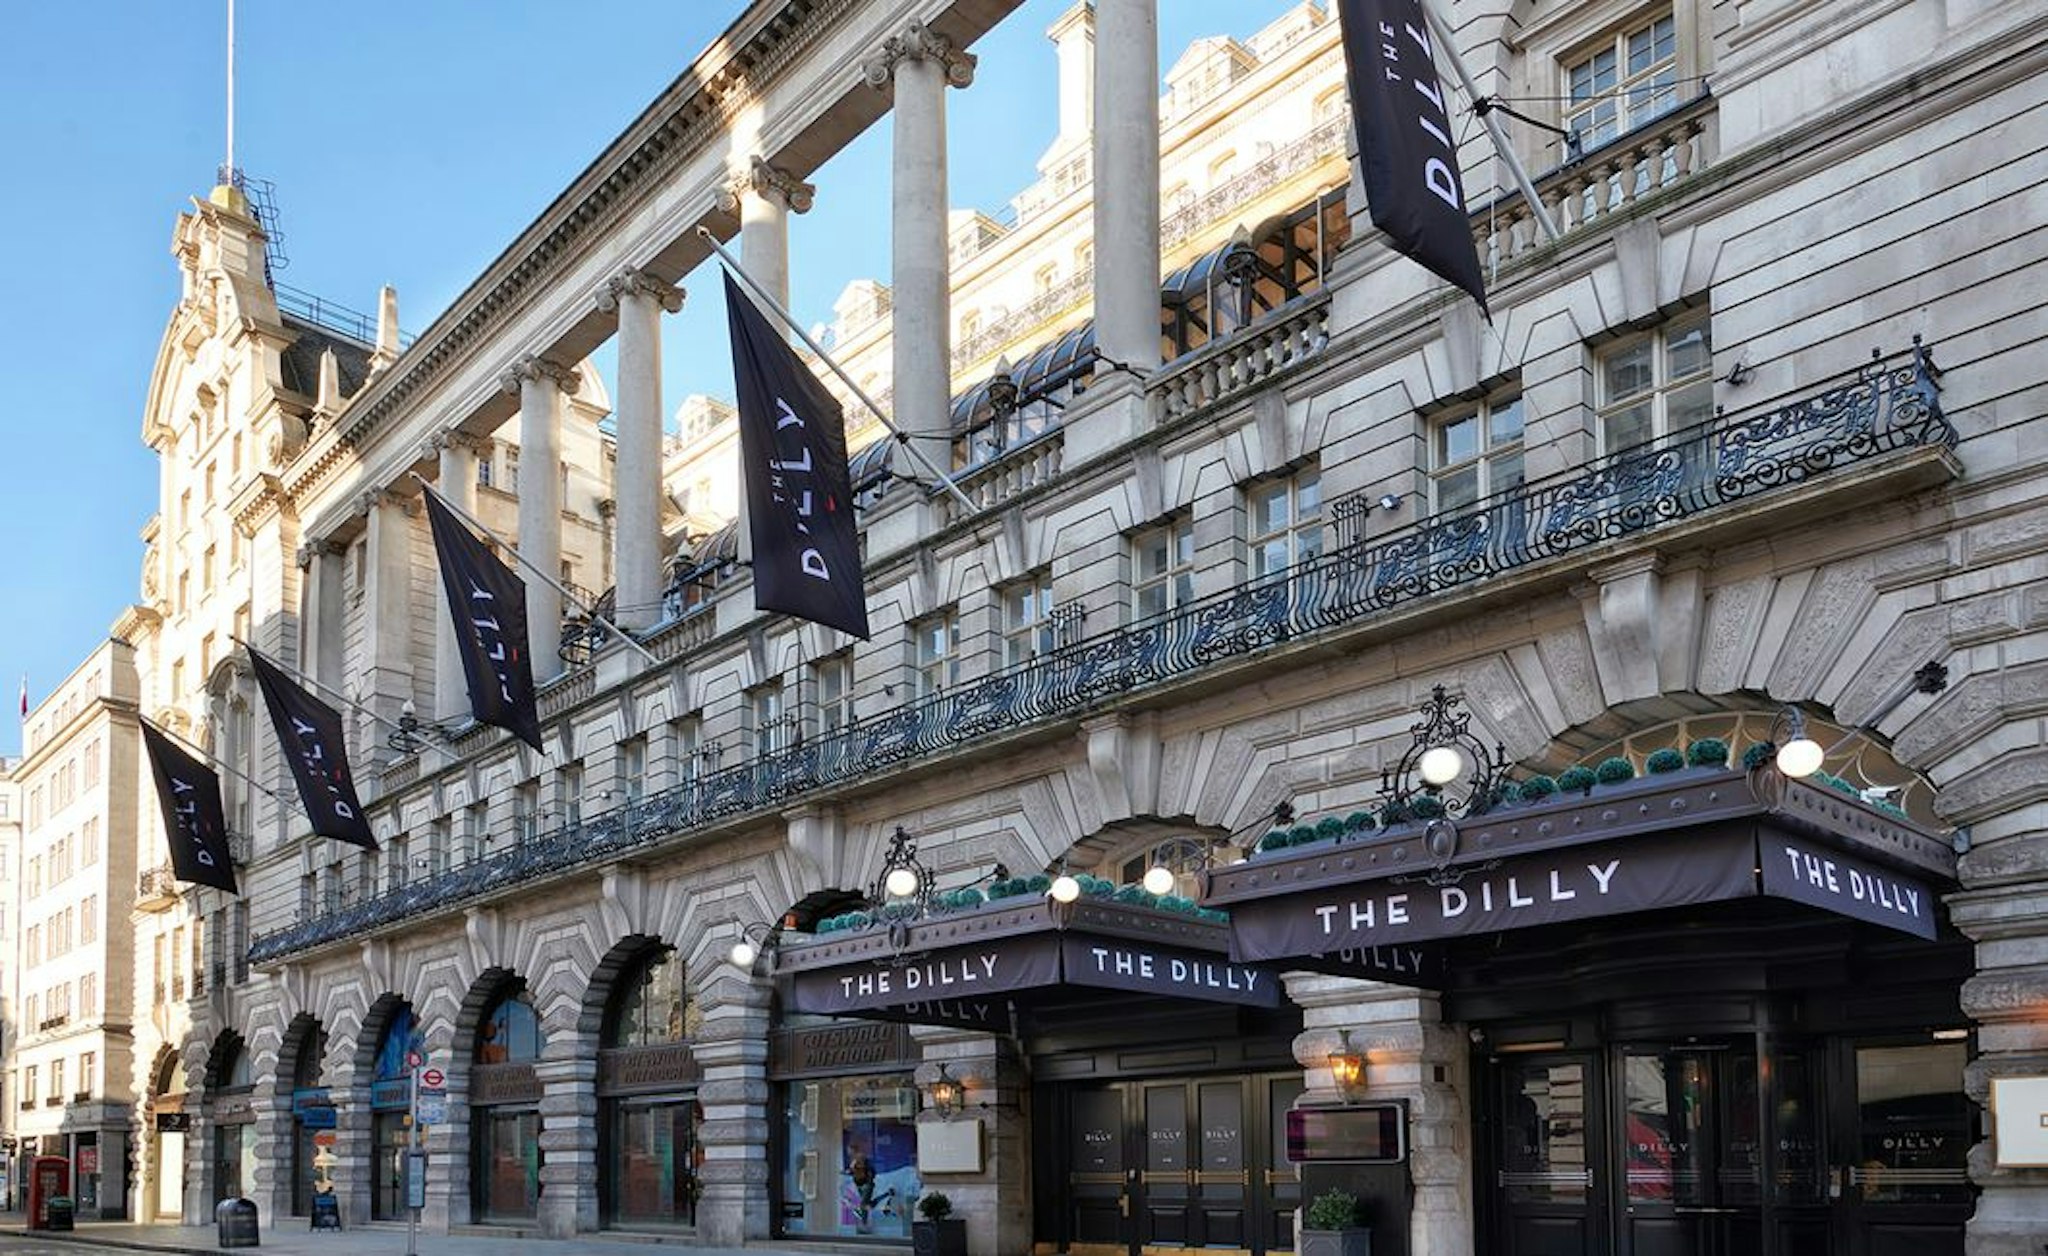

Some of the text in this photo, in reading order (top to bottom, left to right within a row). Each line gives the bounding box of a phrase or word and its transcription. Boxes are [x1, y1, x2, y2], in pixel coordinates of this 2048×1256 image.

[1379, 21, 1401, 82] THE
[1406, 0, 1461, 210] DILL
[769, 458, 785, 504] THE
[1315, 860, 1621, 934] THE DILLY
[1786, 847, 1919, 918] THE DILLY
[840, 953, 998, 998] THE DILLY
[1092, 947, 1258, 991] THE DILLY
[1152, 1130, 1181, 1139] DILLY
[1639, 1142, 1688, 1152] DILLY
[1883, 1137, 1943, 1149] DILLY
